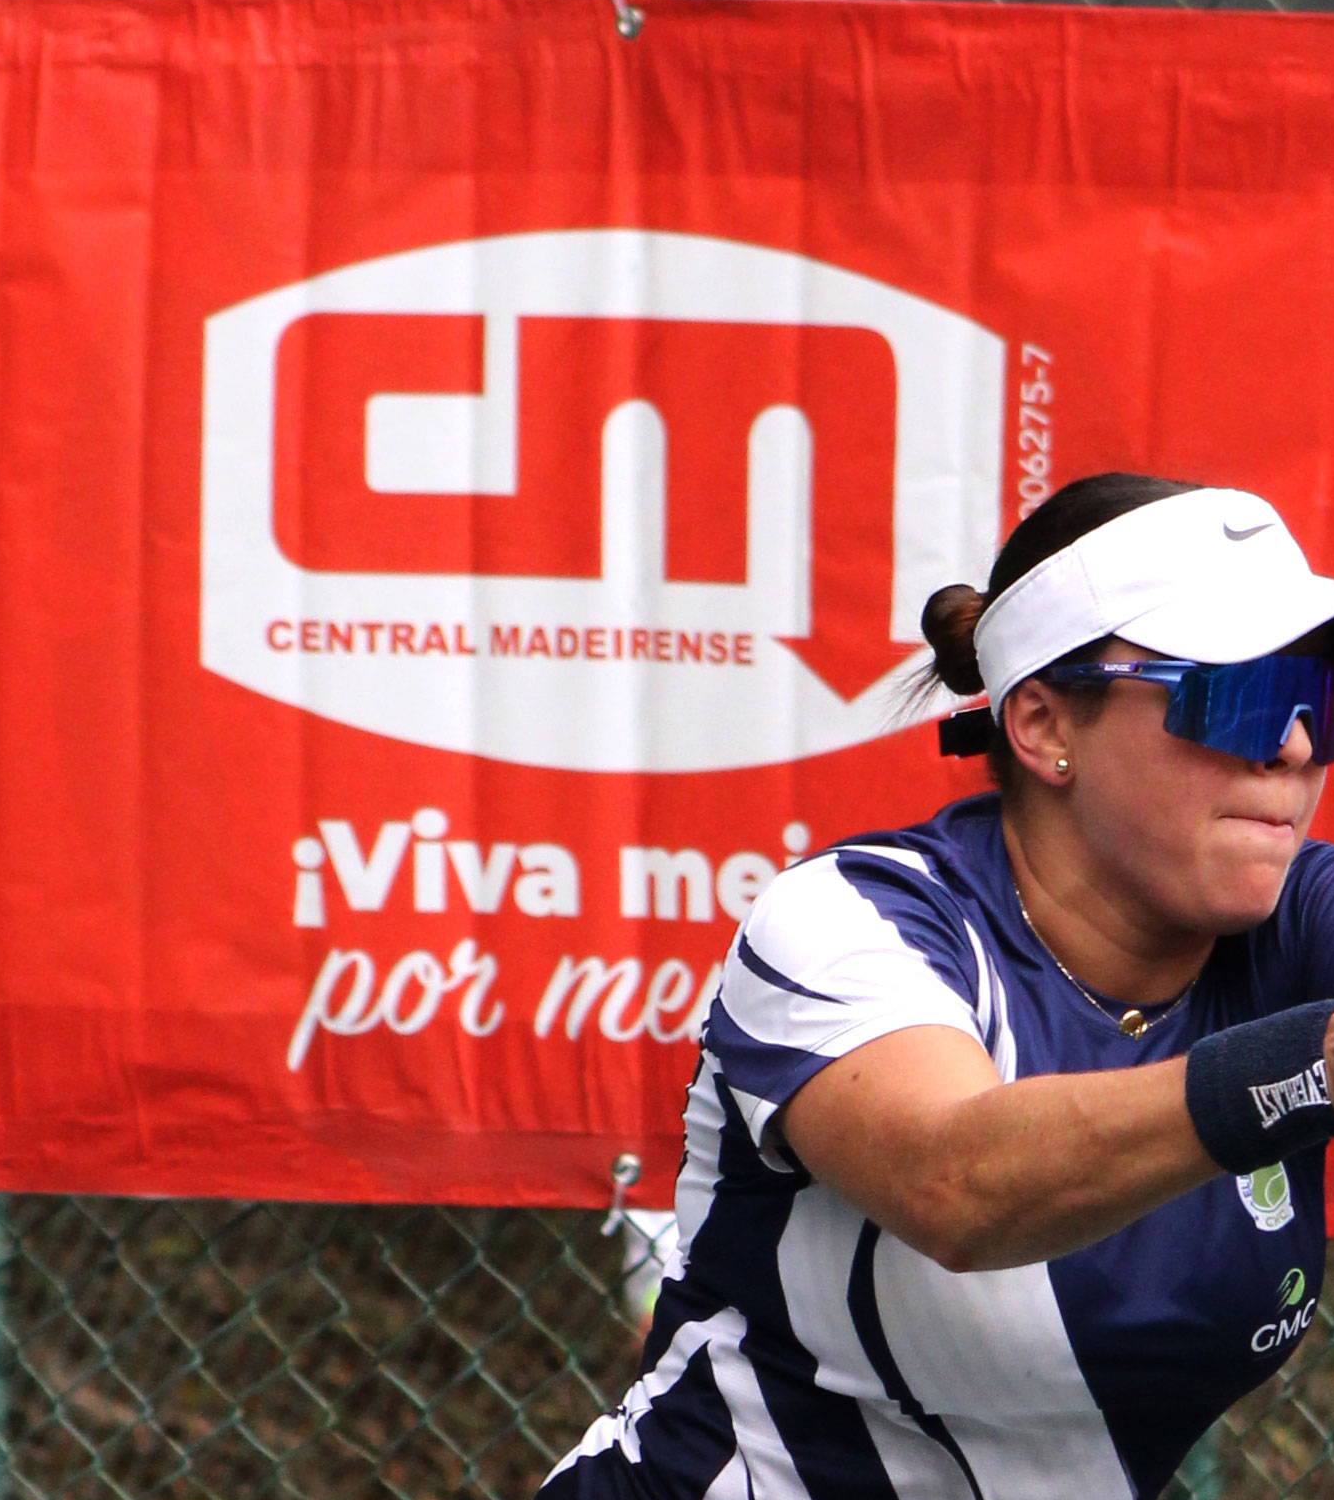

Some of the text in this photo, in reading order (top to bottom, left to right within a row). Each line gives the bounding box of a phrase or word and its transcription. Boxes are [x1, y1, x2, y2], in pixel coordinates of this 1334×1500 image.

[265, 620, 755, 667] CENTRAL MADEIRENSE
[292, 807, 811, 929] ¡Viva me
[286, 937, 723, 1073] por me
[1248, 1059, 1332, 1130] EVERLAST
